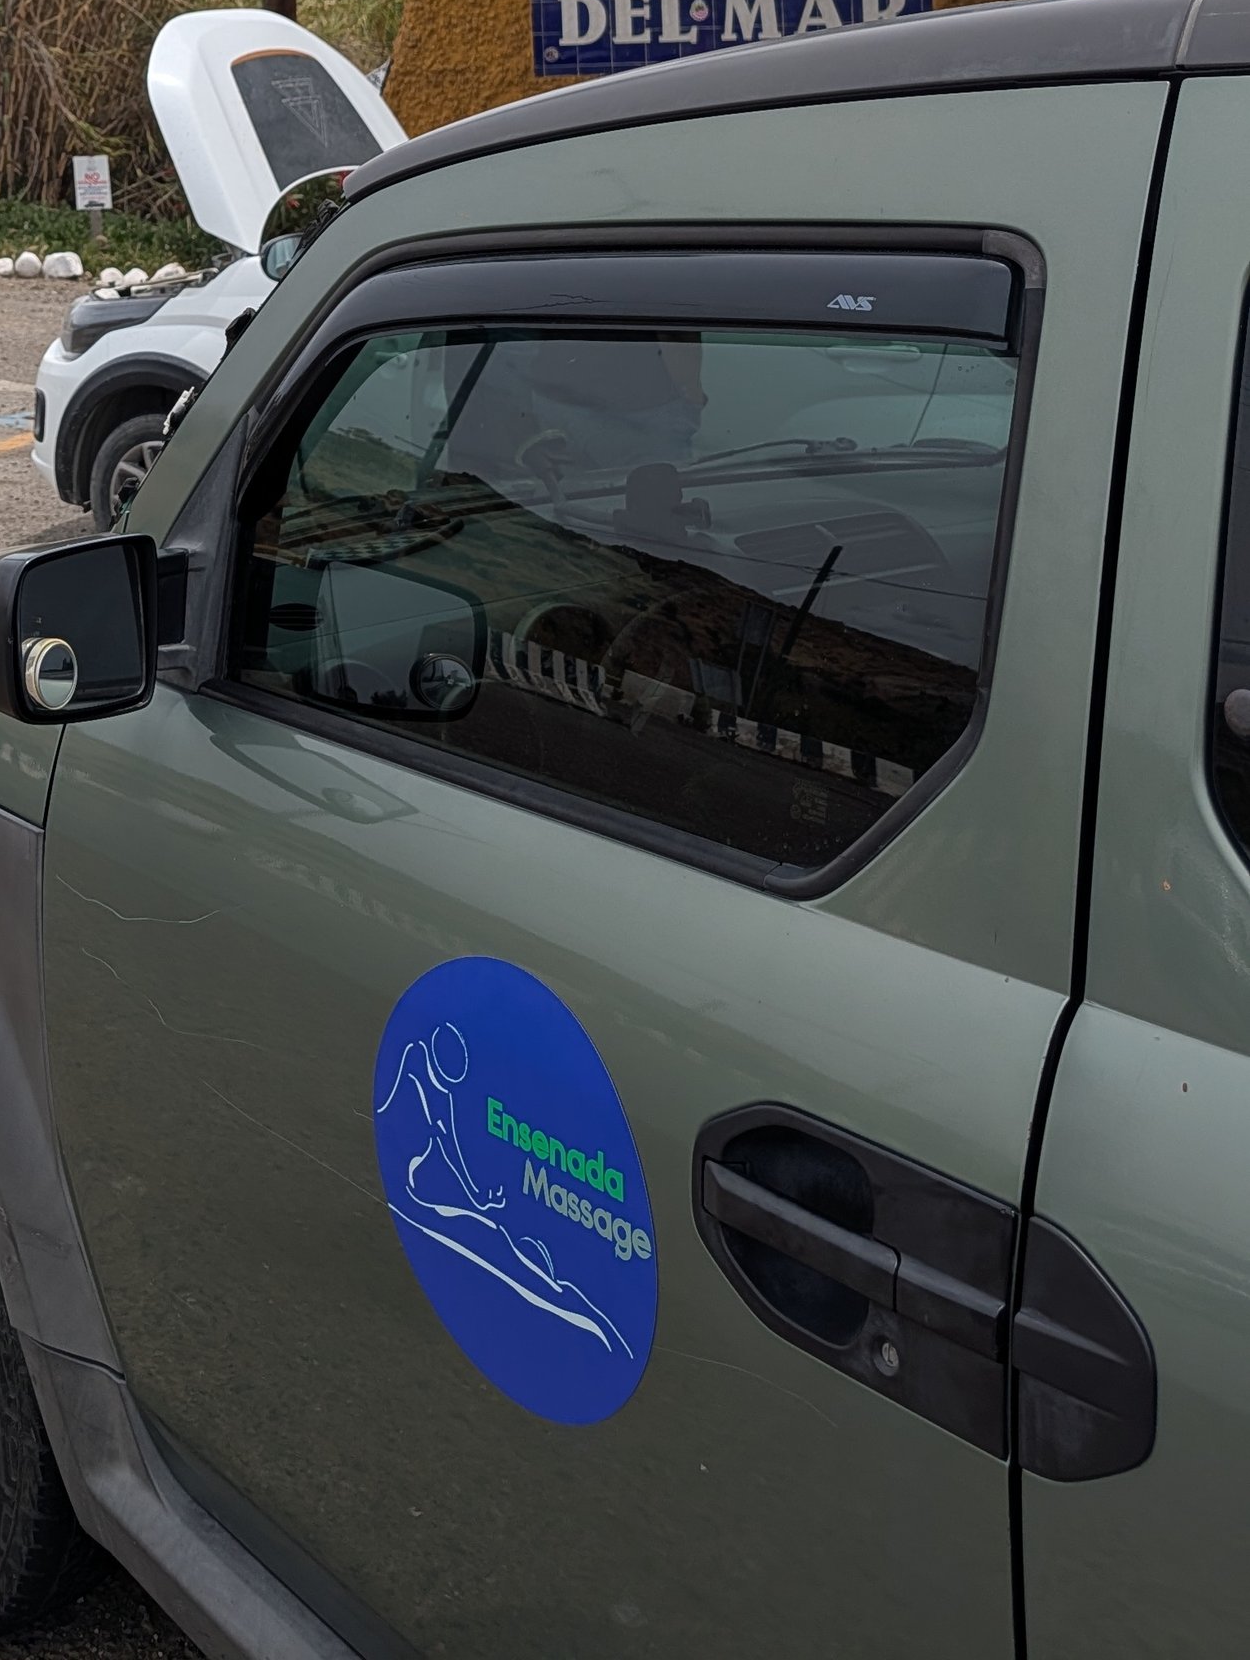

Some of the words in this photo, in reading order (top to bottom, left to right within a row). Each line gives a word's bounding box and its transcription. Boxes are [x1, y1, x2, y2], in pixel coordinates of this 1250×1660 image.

[827, 294, 874, 311] AVS
[488, 1097, 624, 1203] Ensenada
[522, 1157, 652, 1261] Massage
